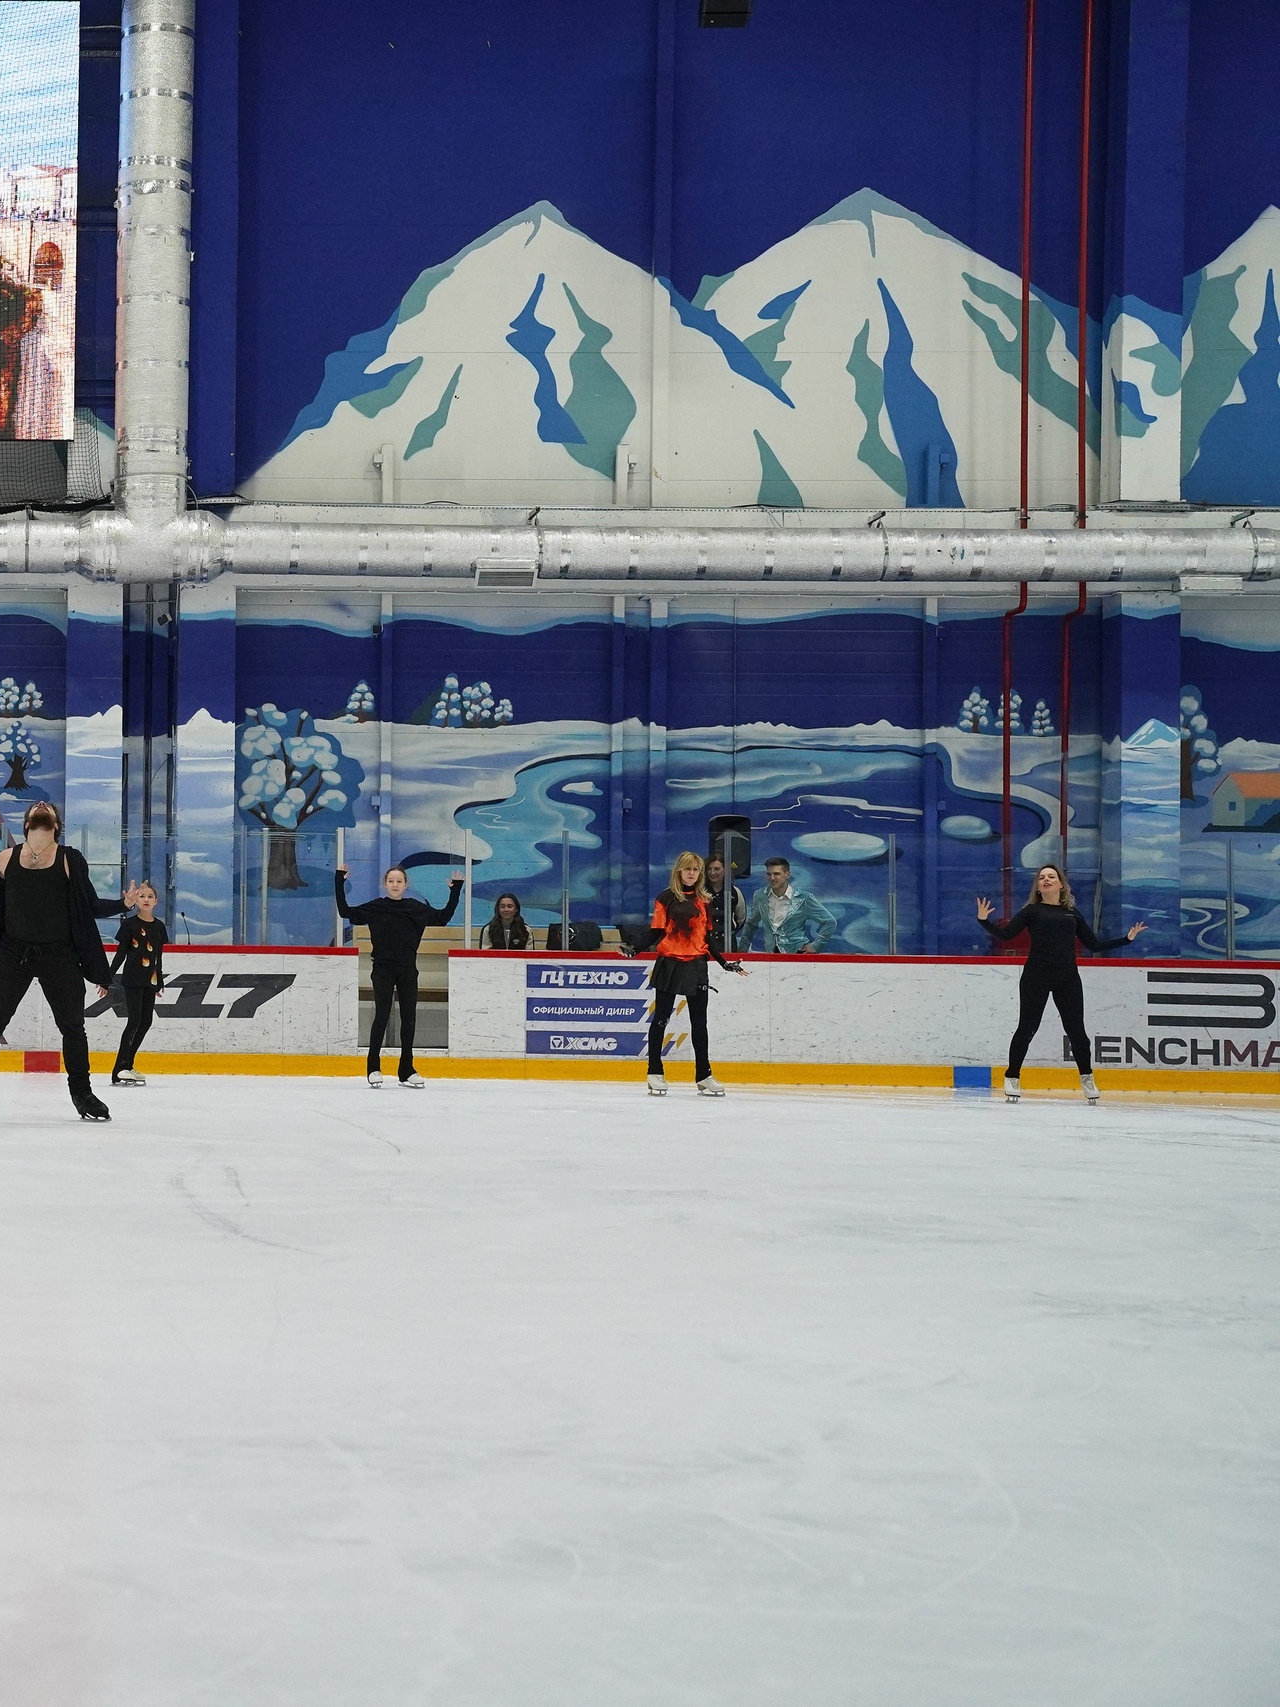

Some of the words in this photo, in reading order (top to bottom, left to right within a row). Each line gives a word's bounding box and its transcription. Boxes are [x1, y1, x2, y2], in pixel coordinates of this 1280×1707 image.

[540, 970, 565, 987] ГЦ
[567, 971, 629, 985] ТЕХНО
[532, 1005, 604, 1016] ОФИЦИАЛЬНЫЙ
[606, 1007, 635, 1016] ДИЛЕР
[564, 1036, 618, 1051] XCMG
